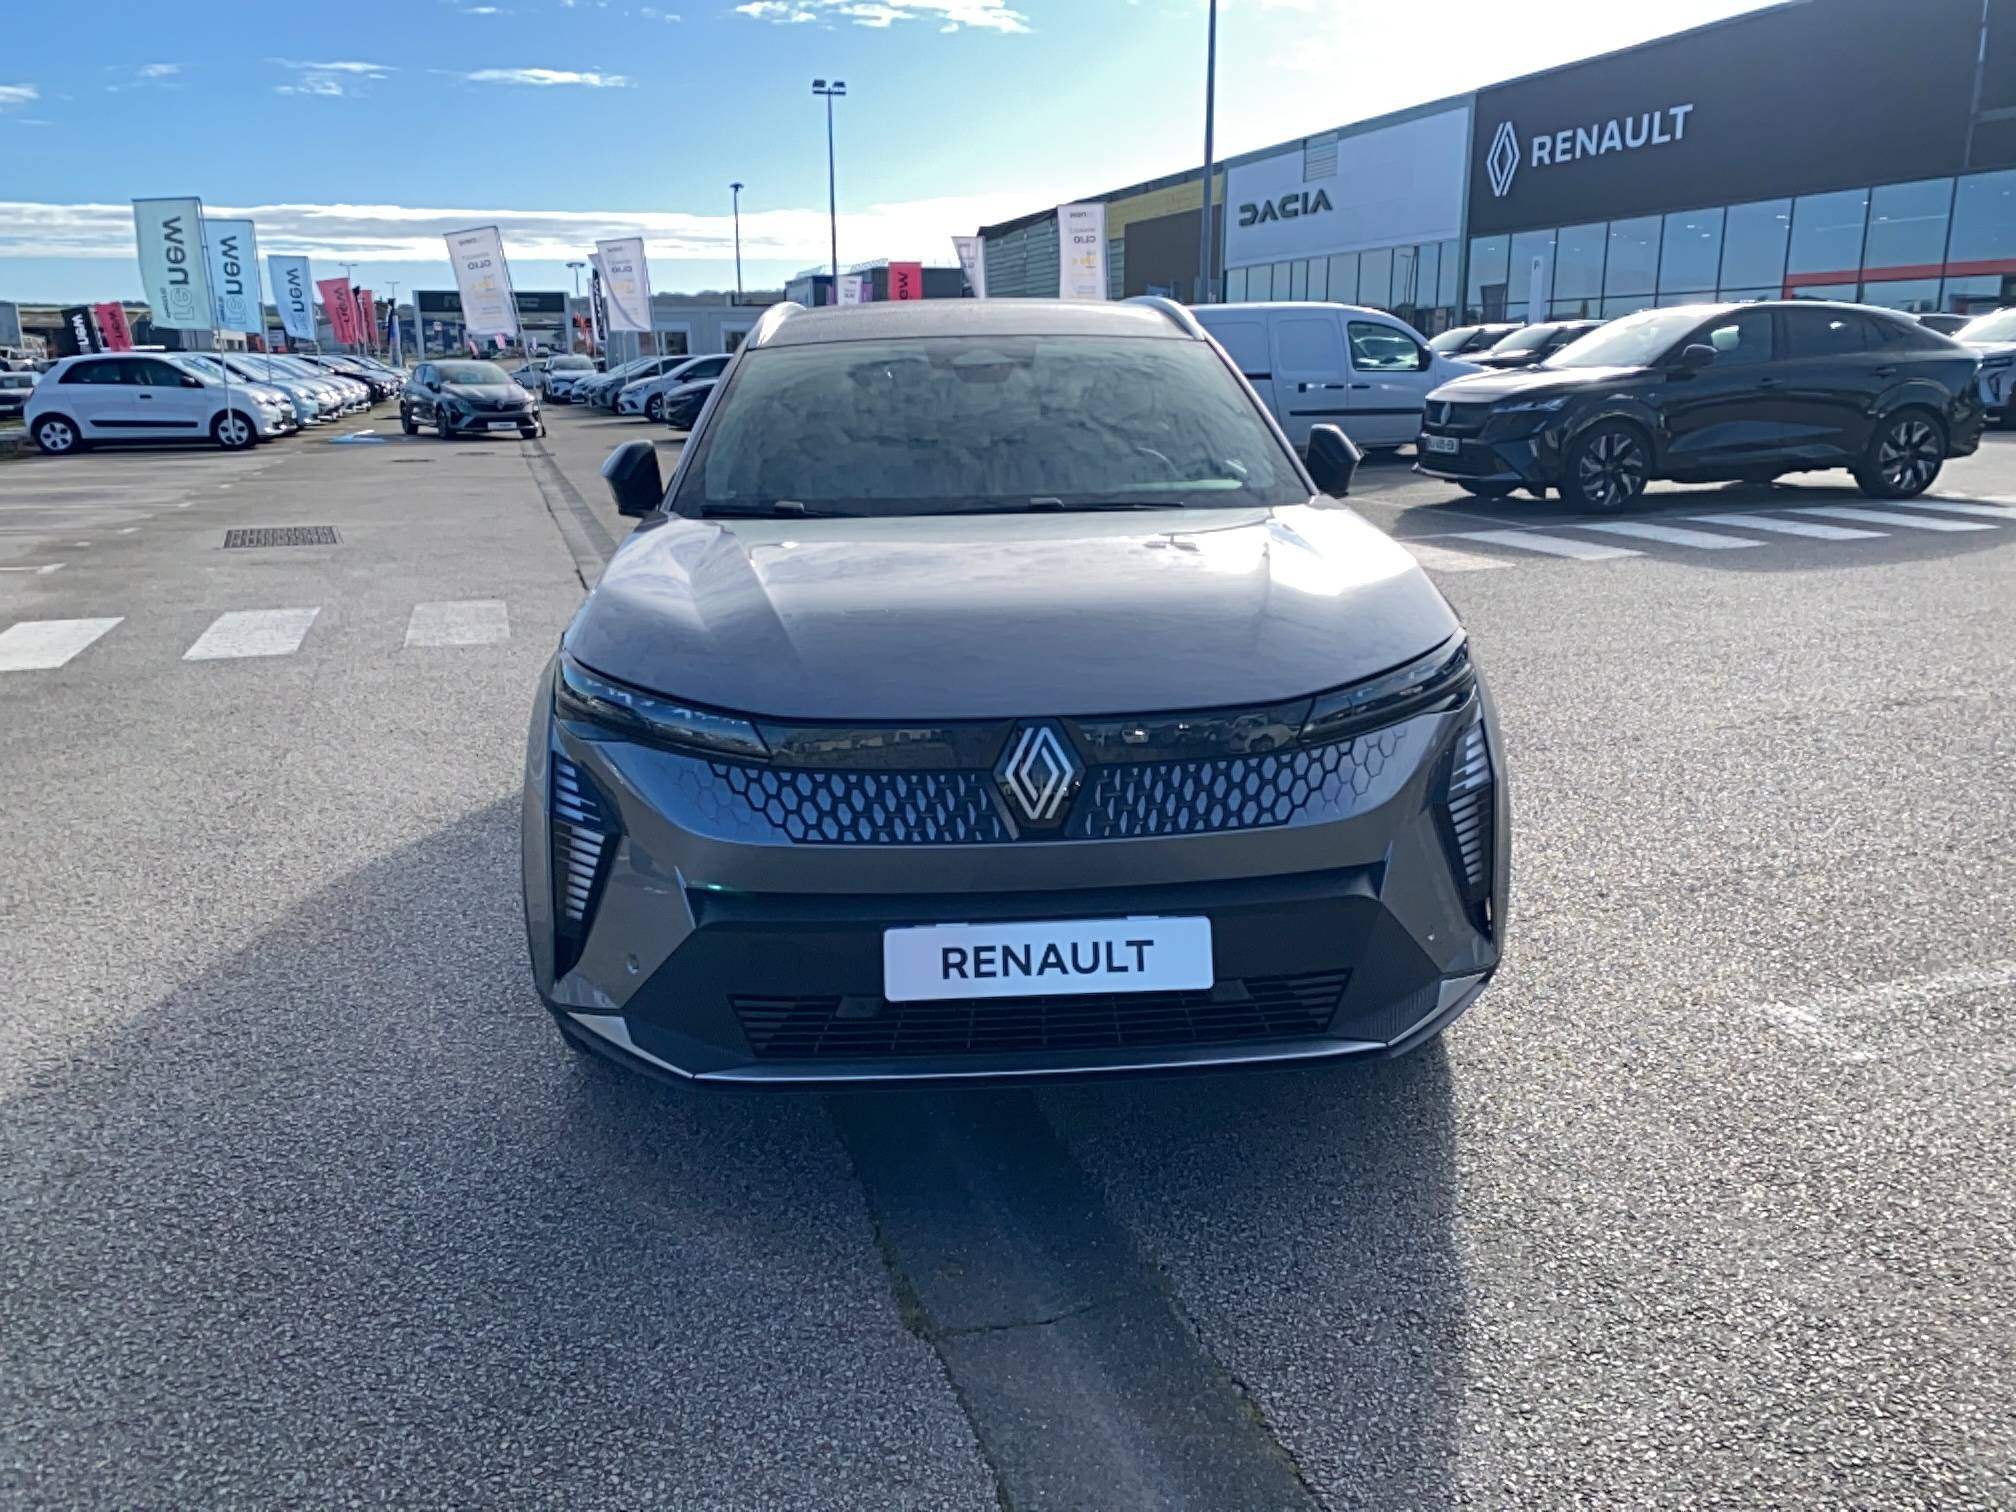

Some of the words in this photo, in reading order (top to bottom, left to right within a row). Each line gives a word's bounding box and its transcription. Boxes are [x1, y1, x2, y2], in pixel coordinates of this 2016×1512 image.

[1531, 103, 1694, 168] RENAULT
[1238, 188, 1334, 227] DACIA
[941, 940, 1154, 980] RENAULT
